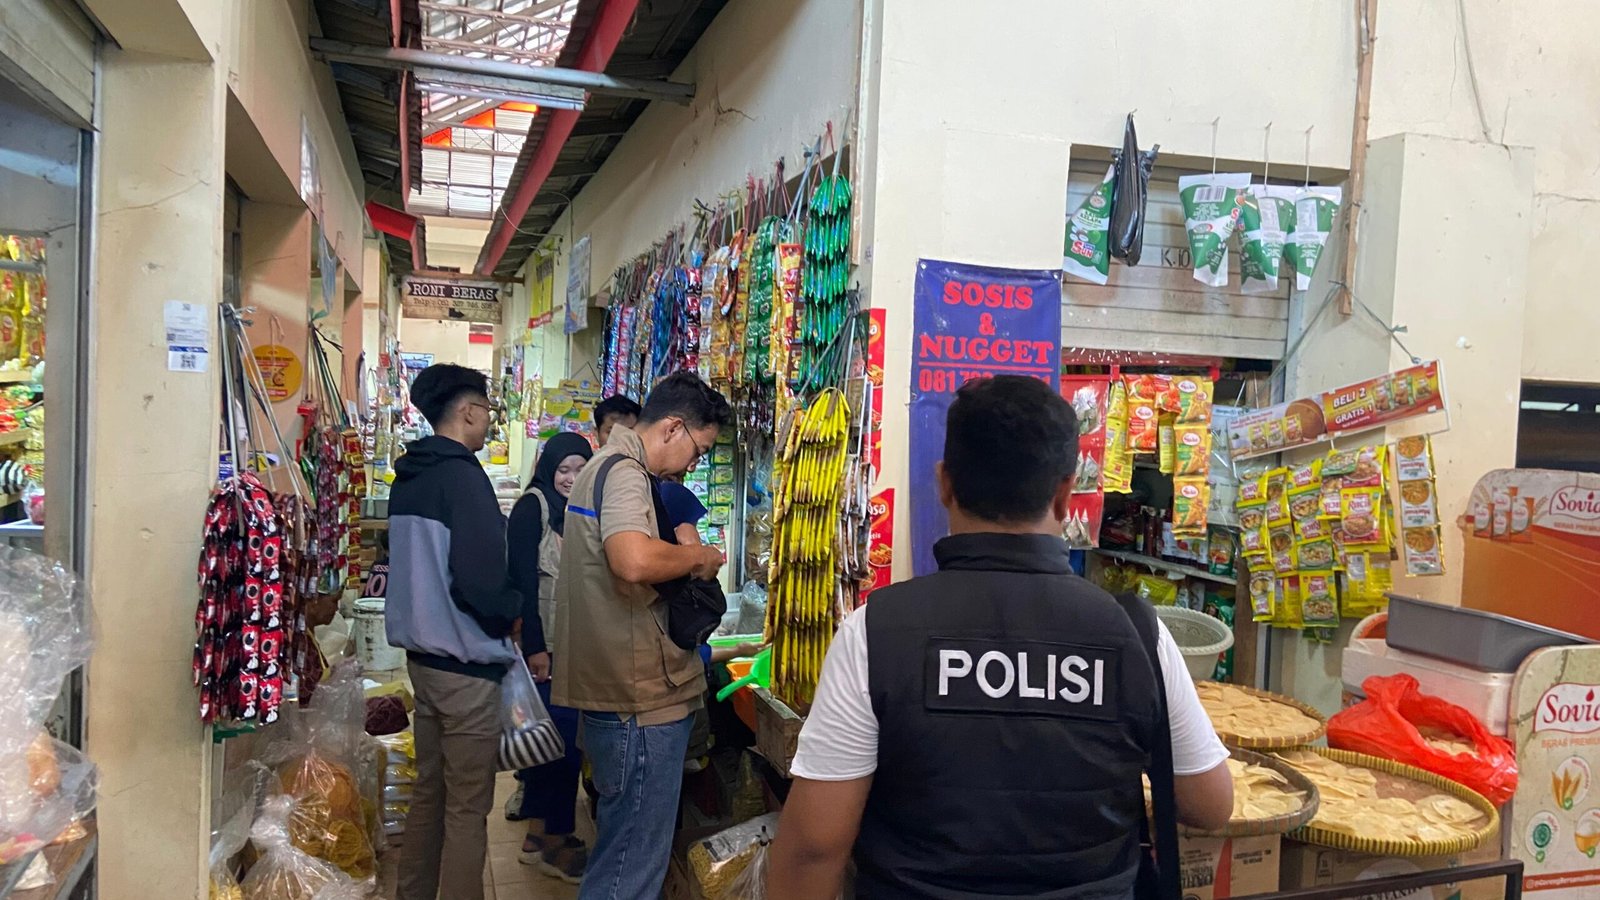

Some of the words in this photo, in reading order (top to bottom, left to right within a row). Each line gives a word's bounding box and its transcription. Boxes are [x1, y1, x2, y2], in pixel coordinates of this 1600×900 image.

[413, 283, 445, 296] RONI
[451, 286, 494, 300] BERAS
[943, 281, 1033, 310] SOSIS
[978, 312, 996, 336] &
[919, 334, 1054, 364] NUGGET
[1333, 391, 1355, 408] BELI
[1359, 387, 1366, 398] 2
[1335, 407, 1365, 424] GRATIS
[938, 649, 1104, 706] POLISI
